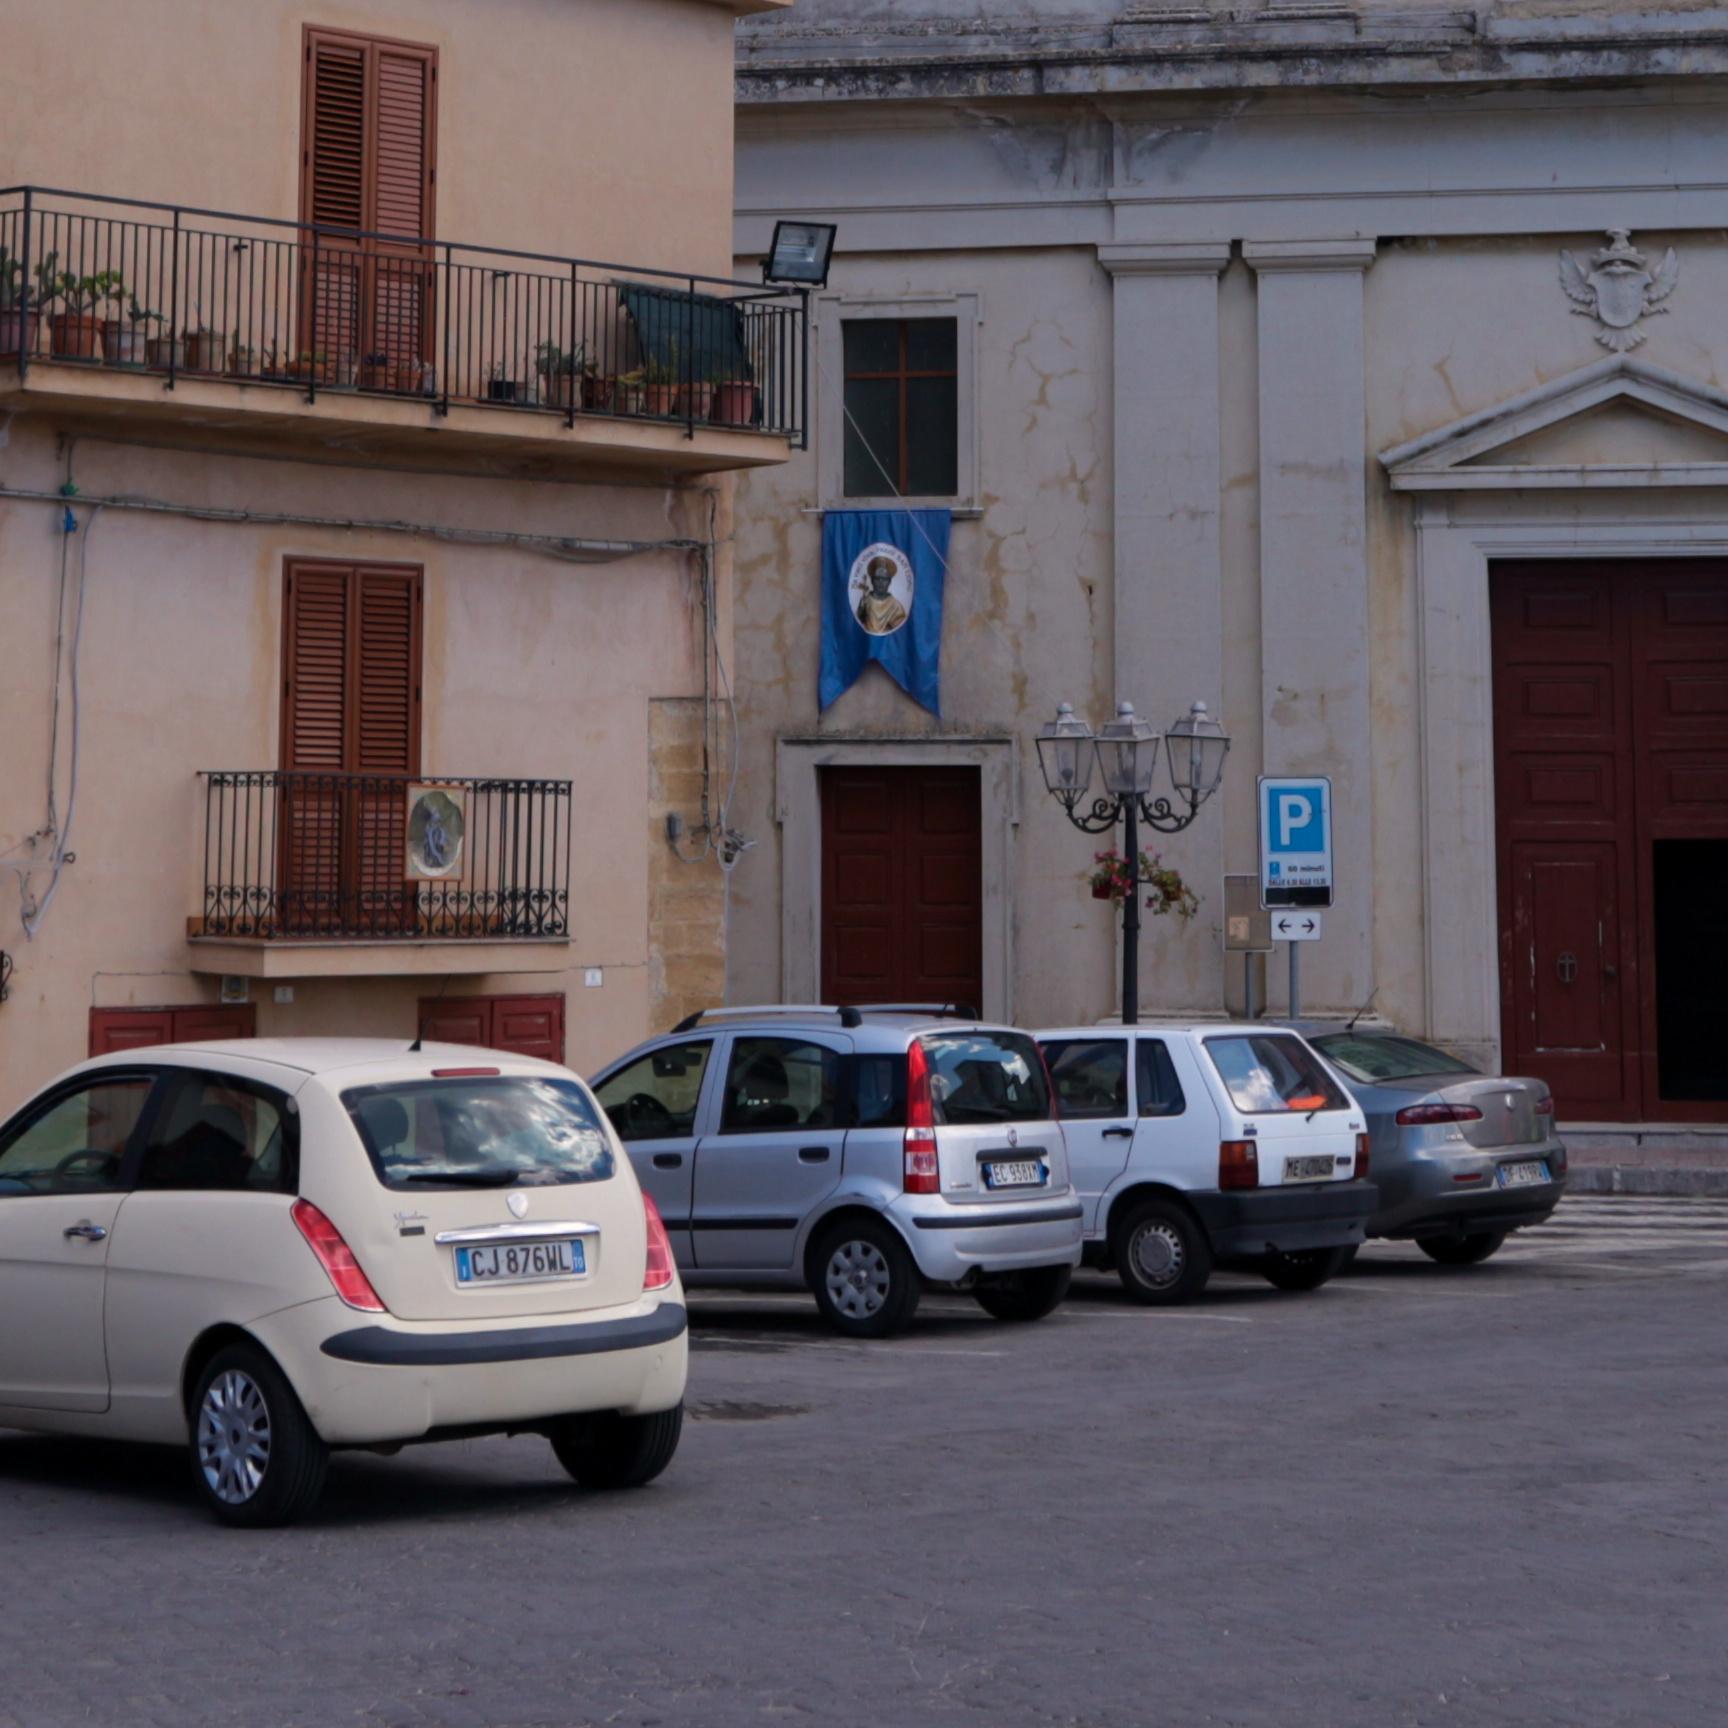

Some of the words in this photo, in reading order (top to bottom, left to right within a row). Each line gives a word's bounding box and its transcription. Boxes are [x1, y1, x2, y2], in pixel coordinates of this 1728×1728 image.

[1279, 794, 1313, 846] P
[472, 1249, 499, 1276] CJ
[506, 1244, 570, 1273] 876WL
